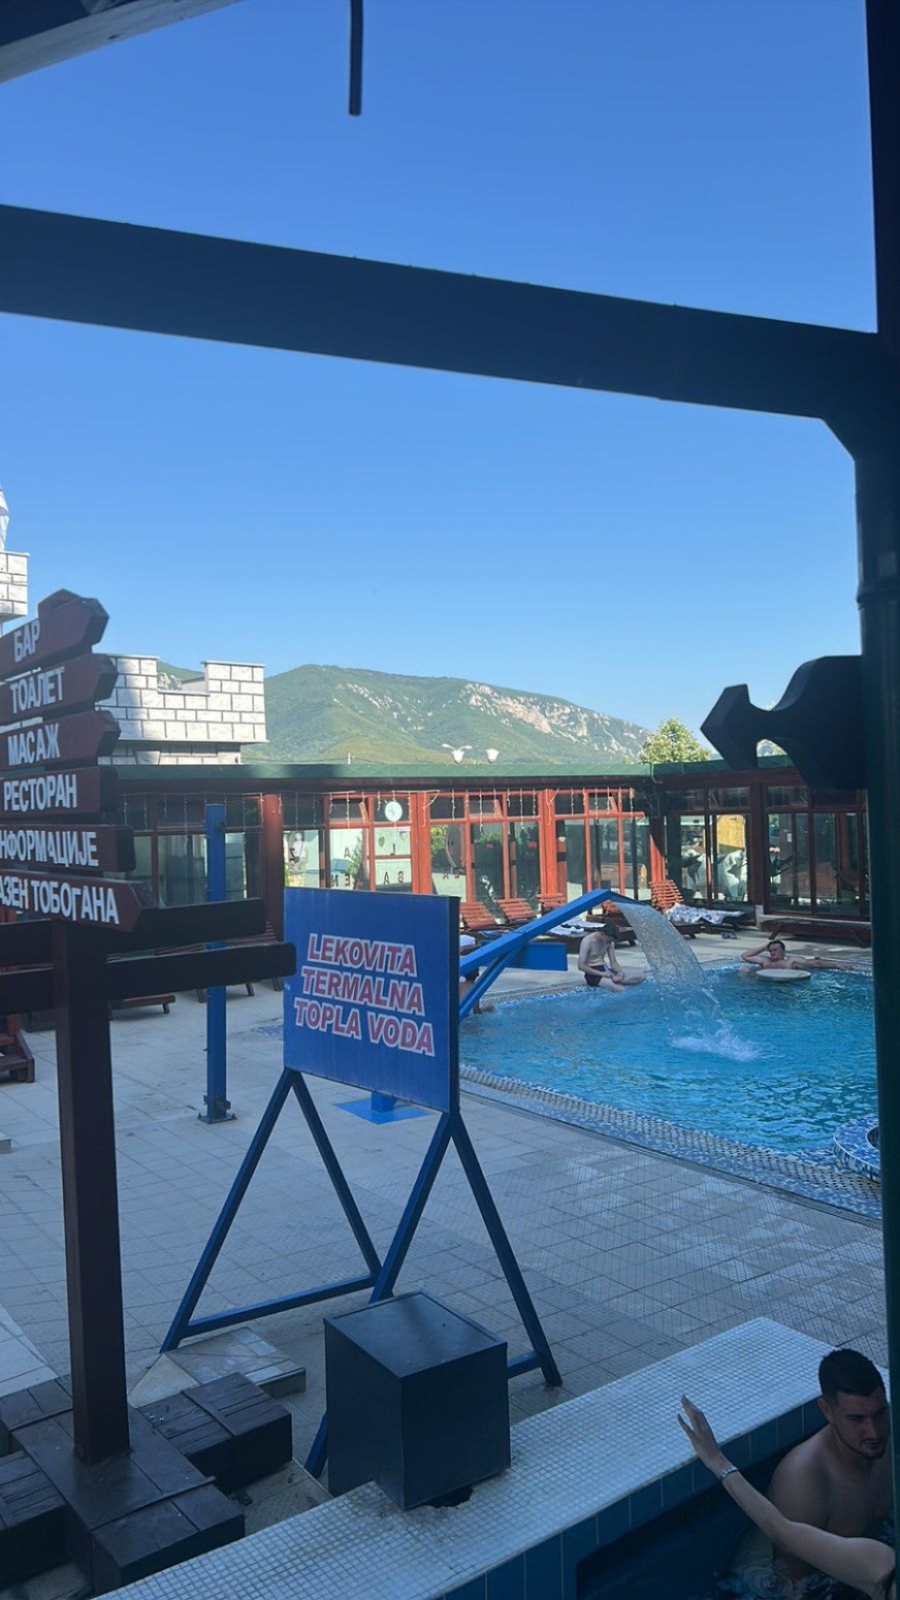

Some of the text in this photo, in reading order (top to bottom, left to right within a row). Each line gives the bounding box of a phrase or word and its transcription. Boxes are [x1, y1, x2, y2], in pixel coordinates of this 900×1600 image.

[14, 619, 40, 663] БАР
[10, 666, 65, 714] ТОАЛЕТ
[8, 722, 60, 766] МАСАЖ
[4, 774, 77, 812] РЕСТОРАН
[31, 880, 120, 925] ТОБОГАНА
[307, 933, 417, 977] LEKOVITA
[301, 965, 425, 1016] TERMALNA
[294, 997, 435, 1057] TOPLA VODA
